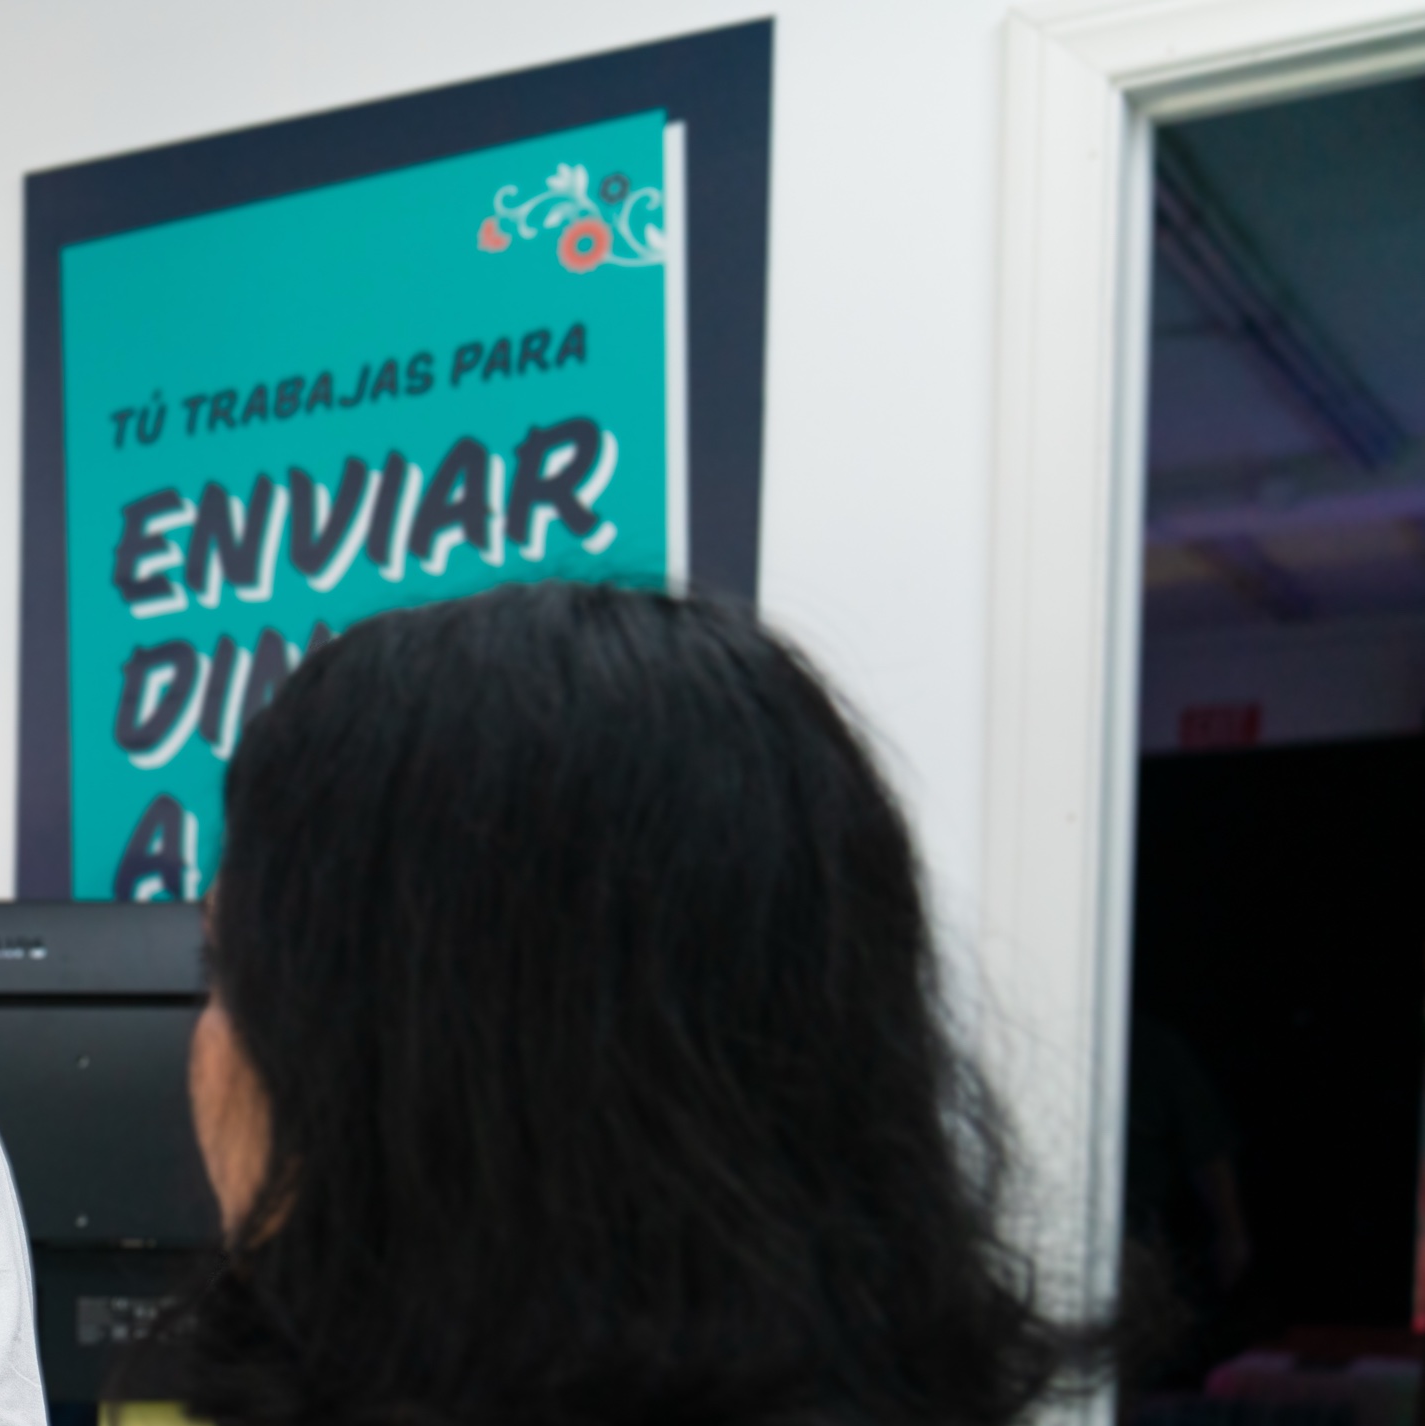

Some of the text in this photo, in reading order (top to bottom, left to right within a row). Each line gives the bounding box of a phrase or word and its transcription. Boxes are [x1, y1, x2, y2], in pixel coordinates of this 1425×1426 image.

[111, 321, 587, 450] TÚ TRABAJAS PARA
[113, 415, 620, 619] ENVIAR
